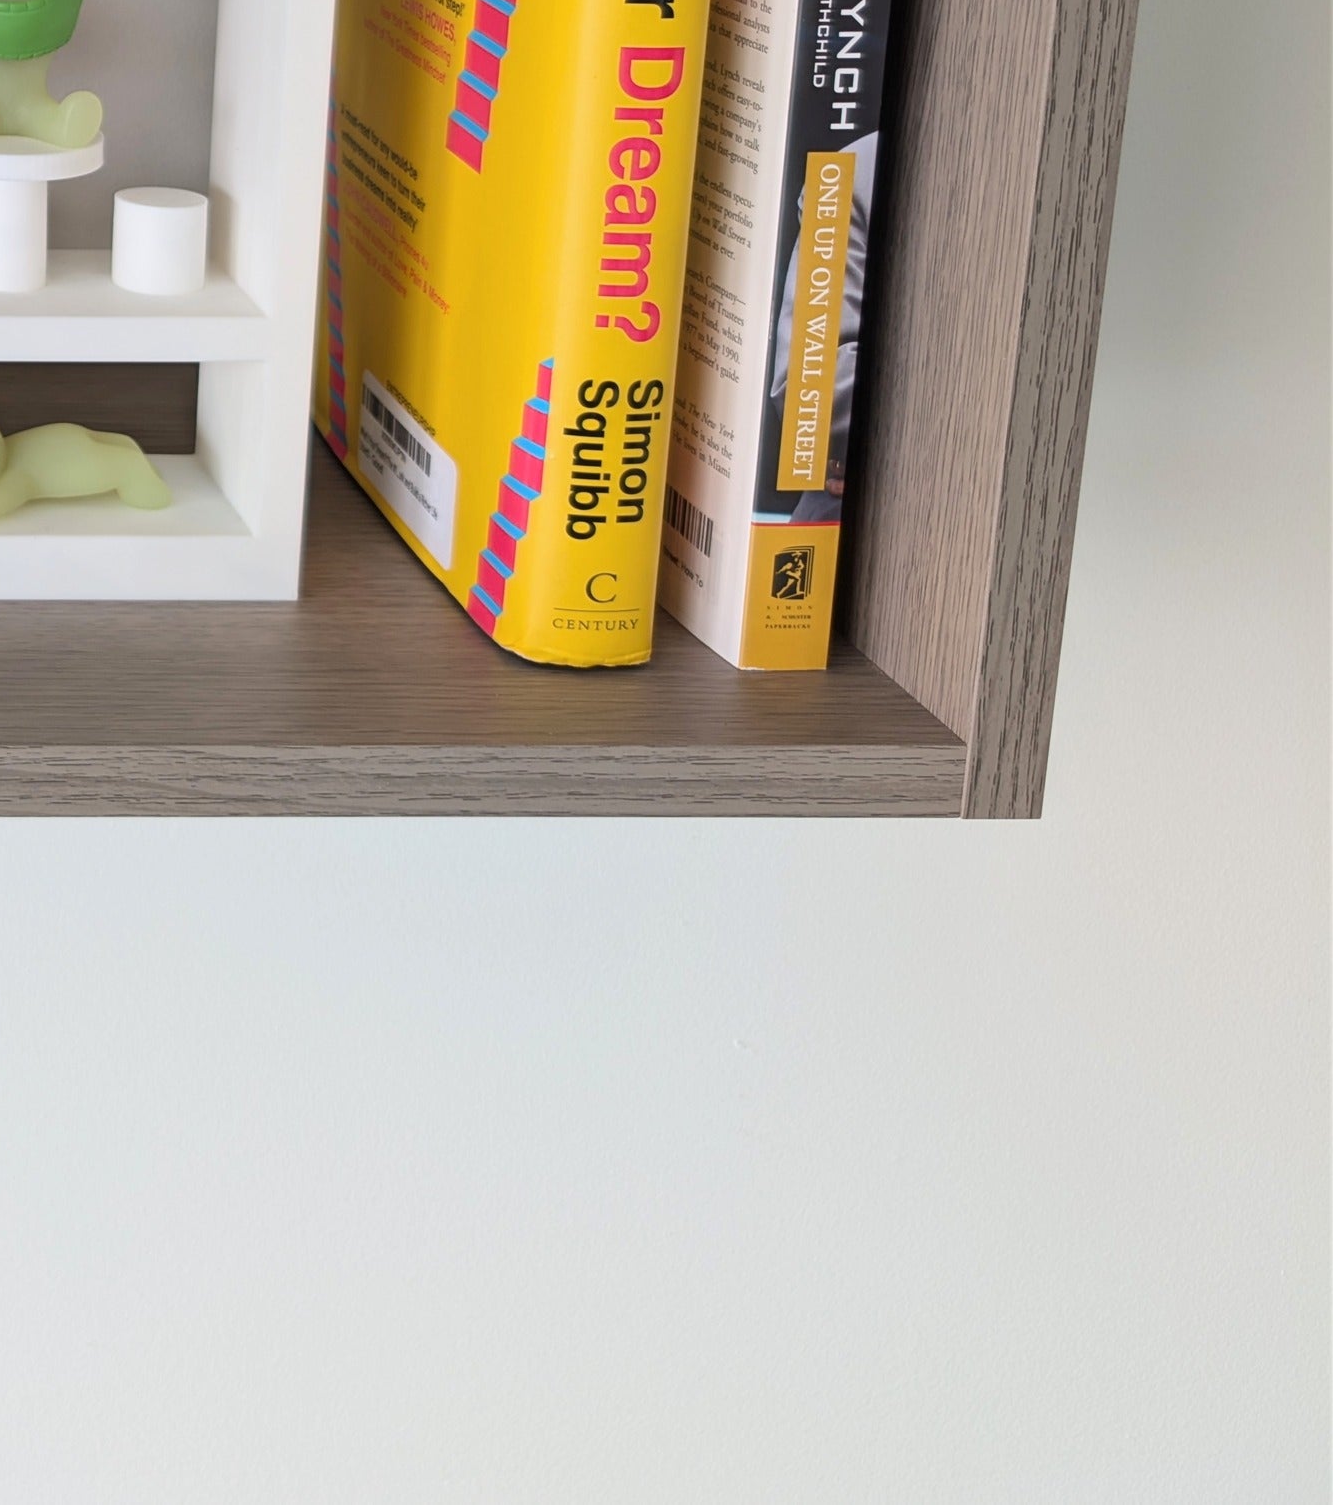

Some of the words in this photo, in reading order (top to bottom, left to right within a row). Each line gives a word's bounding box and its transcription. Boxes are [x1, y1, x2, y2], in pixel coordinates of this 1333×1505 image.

[750, 0, 757, 9] to
[760, 0, 772, 14] the
[743, 17, 769, 34] analysts
[734, 34, 768, 54] appreciate
[742, 76, 764, 93] reveals
[737, 96, 763, 112] easy-to-
[726, 110, 761, 132] company's
[744, 138, 759, 152] stalk
[718, 141, 758, 175] fast-growing
[595, 46, 685, 343] Dream?
[733, 193, 755, 209] specu-
[817, 163, 841, 220] ONE
[724, 211, 753, 229] portfolio
[813, 226, 835, 261] UP
[809, 267, 831, 307] ON
[716, 300, 744, 327] Trustees
[722, 327, 742, 345] which
[721, 343, 740, 365] 1990.
[800, 313, 827, 383] WALL
[720, 365, 740, 384] guide
[719, 423, 734, 442] York
[792, 389, 820, 480] STREET
[616, 379, 664, 523] Simon
[707, 436, 719, 452] also
[721, 445, 732, 460] the
[563, 379, 620, 540] Squibb
[708, 455, 731, 478] Miami
[586, 573, 617, 603] C
[552, 618, 639, 630] CENTURY
